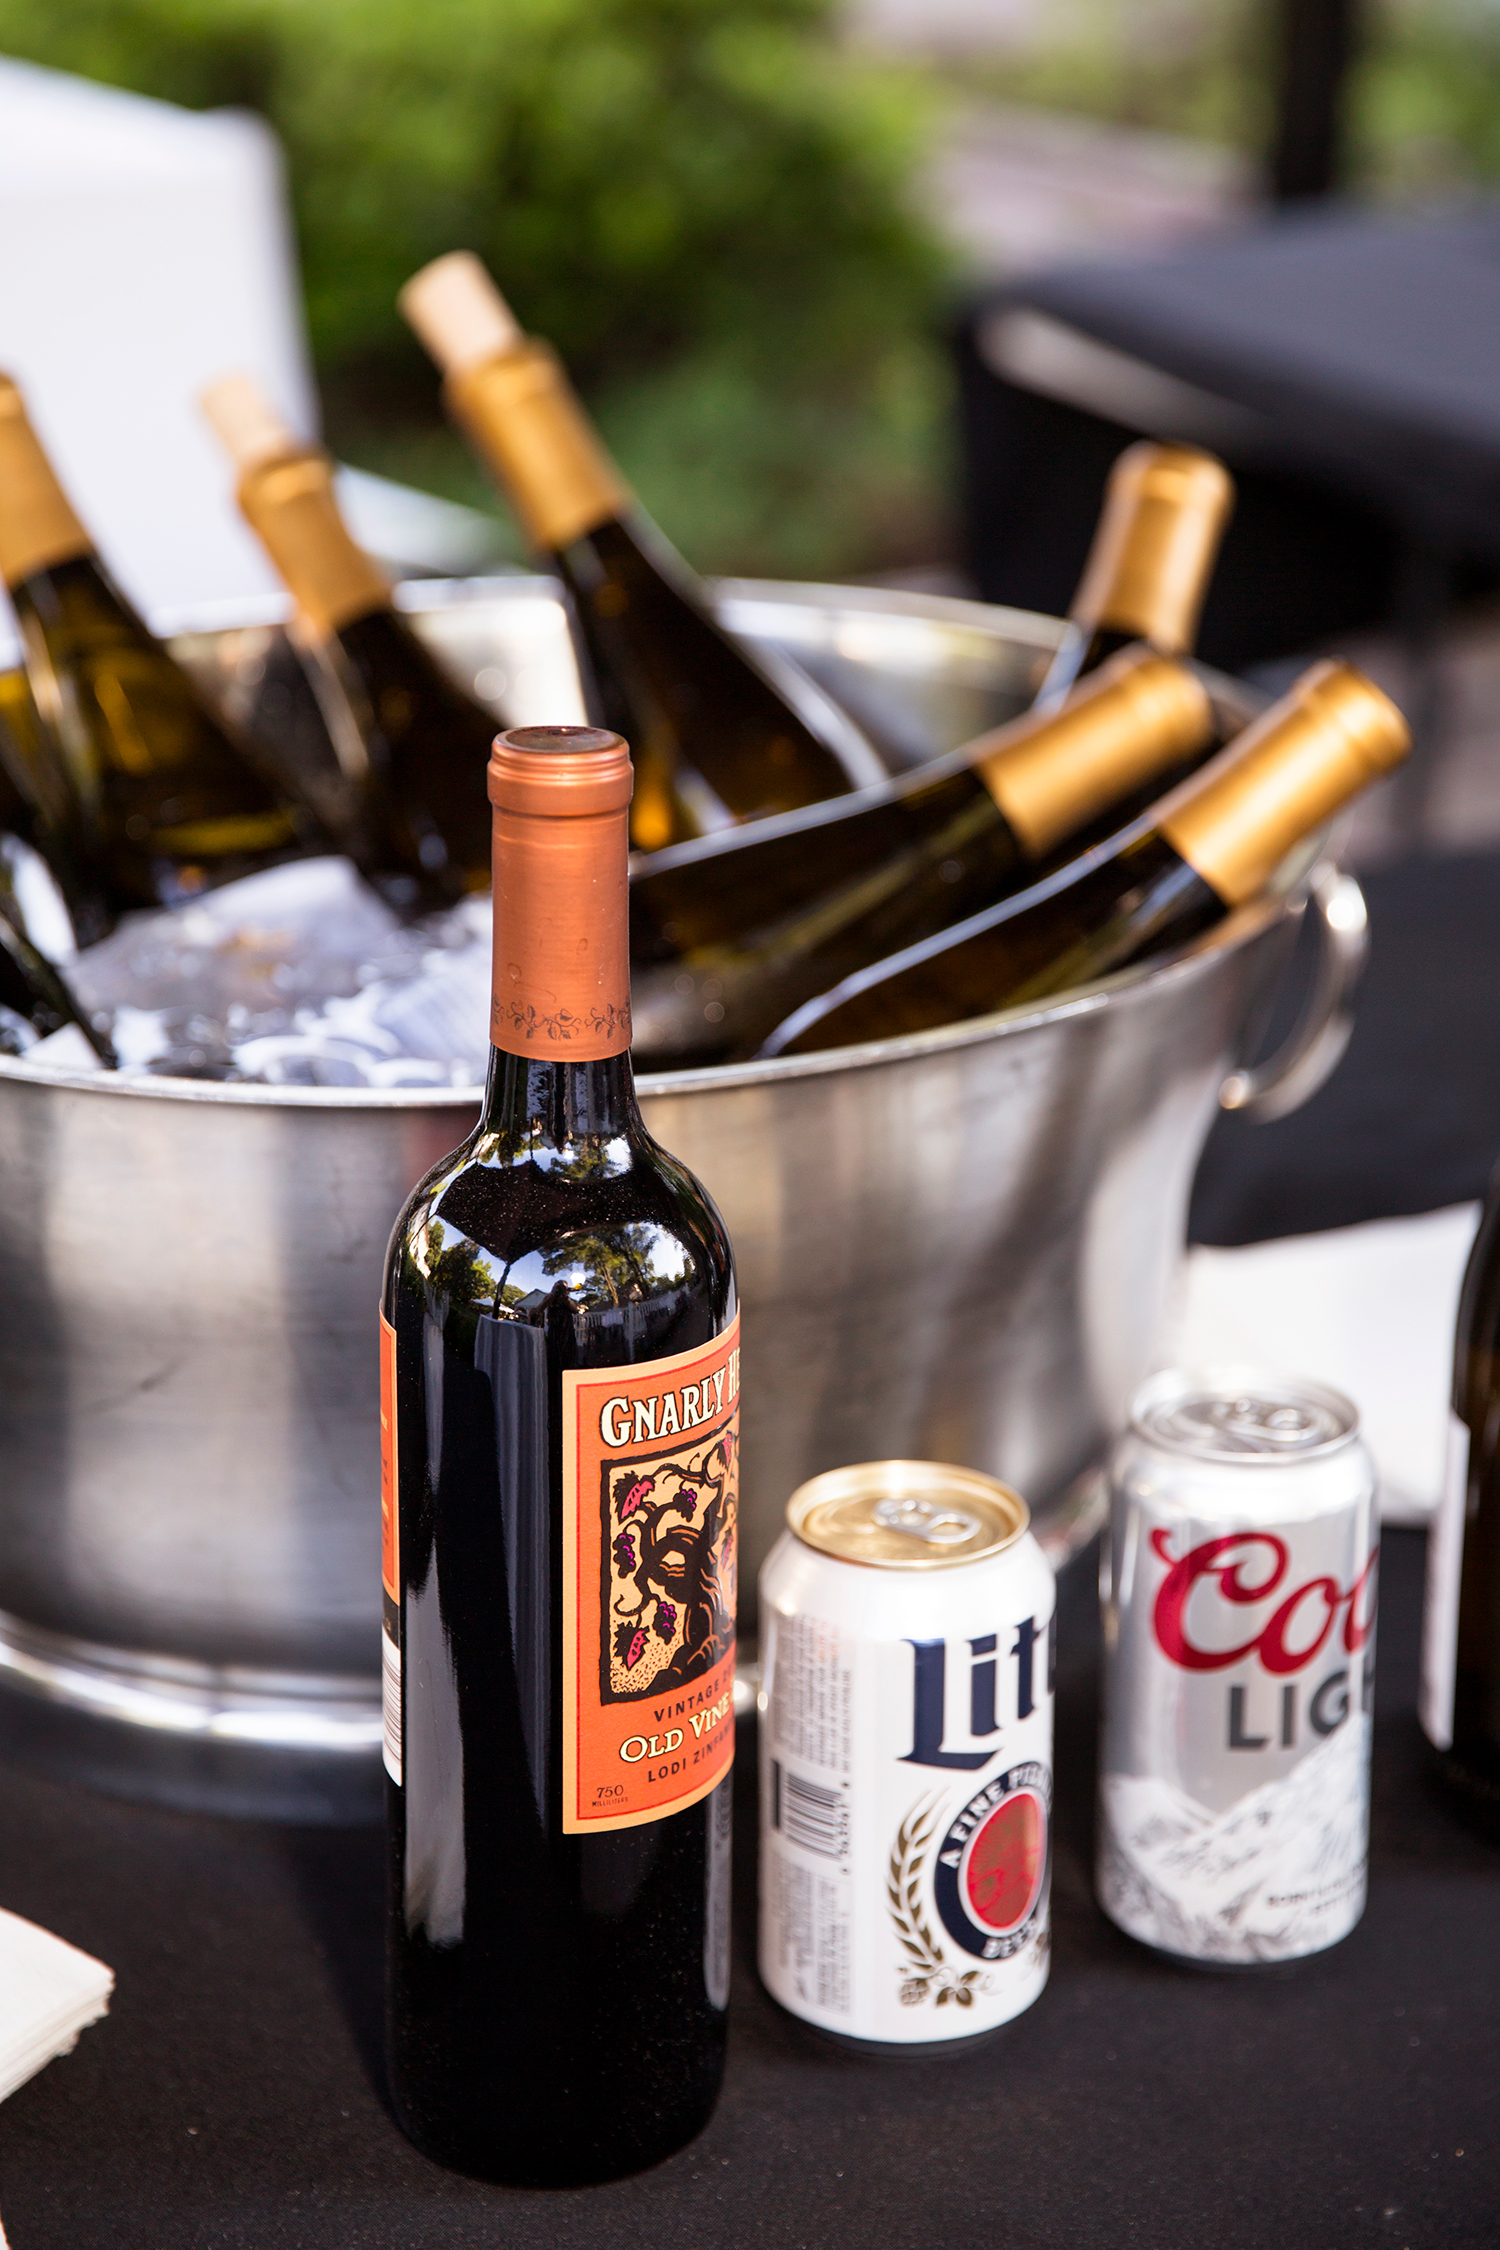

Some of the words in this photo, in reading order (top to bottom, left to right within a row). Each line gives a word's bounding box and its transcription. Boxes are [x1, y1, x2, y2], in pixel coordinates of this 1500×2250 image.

[601, 1364, 726, 1448] GNARLY
[654, 1679, 720, 1722] VINTAGE
[619, 1728, 684, 1763] OLD
[648, 1758, 686, 1782] LODI
[596, 1784, 624, 1799] 750
[949, 1780, 1005, 1842] FINE
[939, 1849, 970, 1869] A
